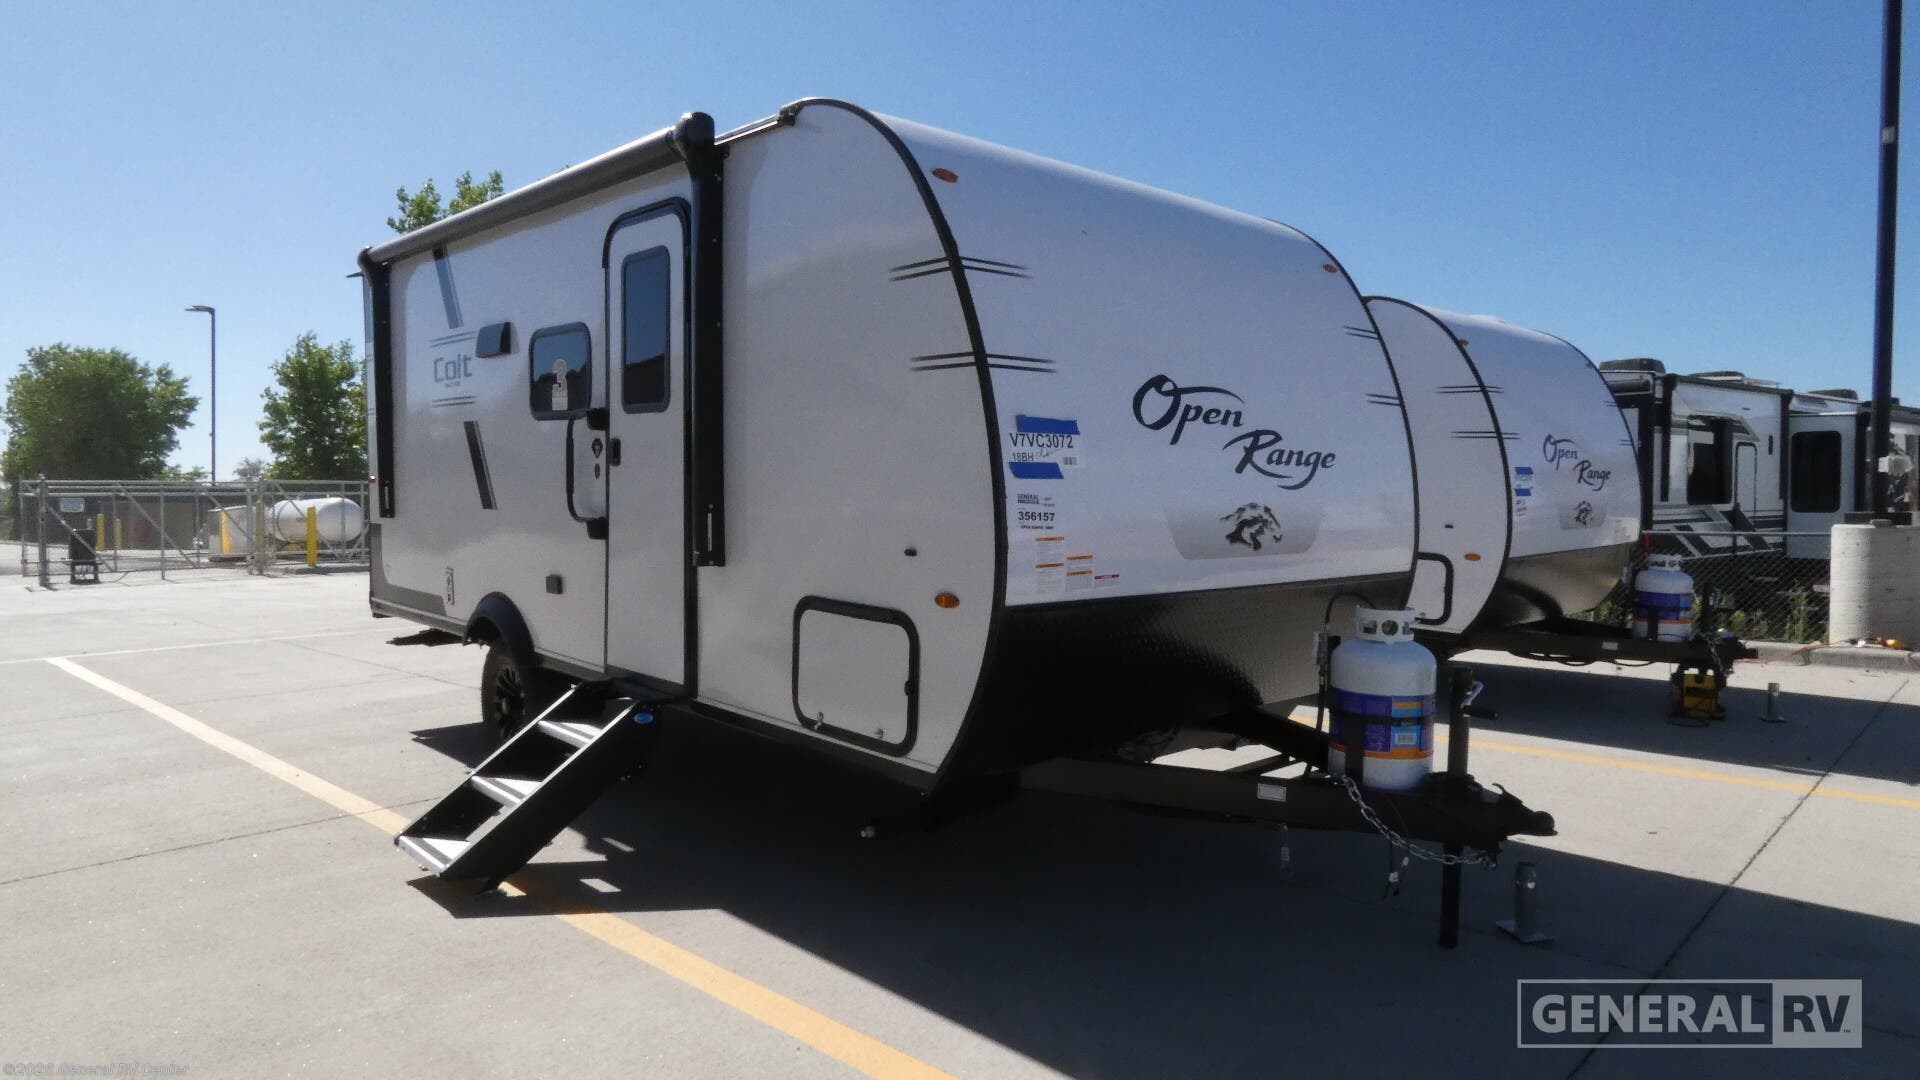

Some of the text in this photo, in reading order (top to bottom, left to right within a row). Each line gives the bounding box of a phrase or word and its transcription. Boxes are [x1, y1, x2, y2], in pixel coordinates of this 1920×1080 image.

[434, 354, 472, 382] Colt
[1133, 374, 1245, 445] Open
[1009, 433, 1074, 449] V7VC3072
[1543, 433, 1578, 471] Open
[1013, 452, 1034, 462] 18BH
[1222, 429, 1336, 490] Range
[1573, 460, 1611, 491] Range
[1017, 511, 1055, 522] 356157
